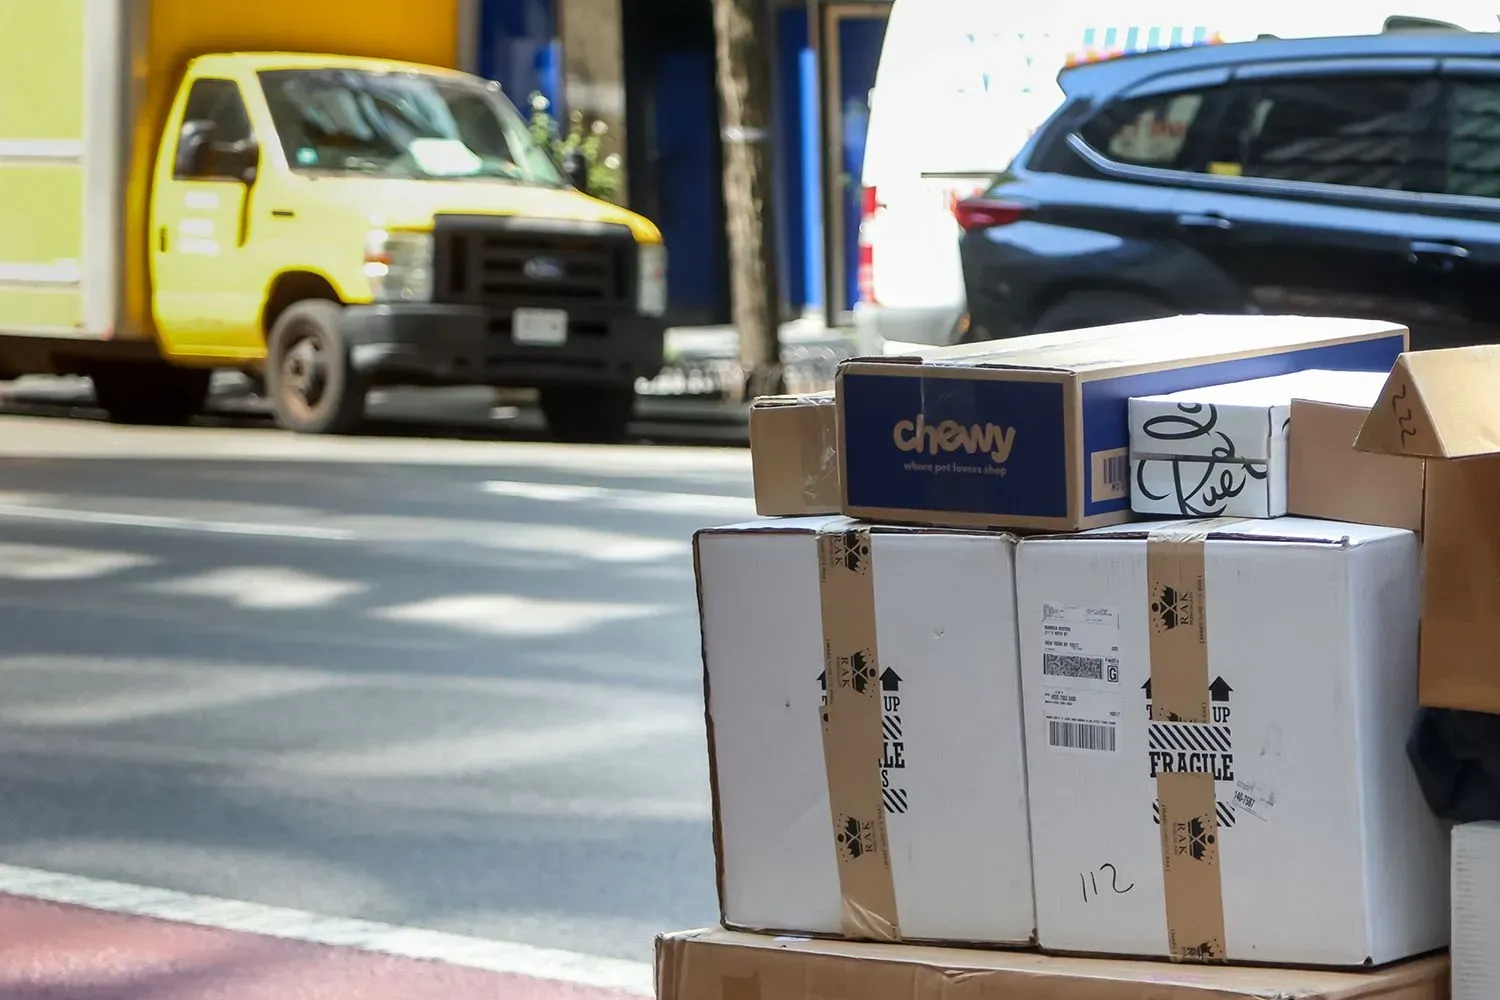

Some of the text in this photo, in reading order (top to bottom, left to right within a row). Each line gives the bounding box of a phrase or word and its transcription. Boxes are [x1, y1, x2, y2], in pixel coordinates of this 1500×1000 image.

[893, 413, 1016, 463] chewy
[904, 461, 1007, 477] where pet lovers shop
[1180, 591, 1190, 625] RAK
[841, 657, 850, 689] RAK
[1109, 667, 1117, 680] G
[884, 696, 900, 712] UP
[1212, 706, 1231, 723] UP
[1149, 751, 1234, 781] FRAGILE
[863, 821, 873, 853] RAK
[1177, 823, 1187, 855] RAK
[1080, 863, 1134, 903] 112
